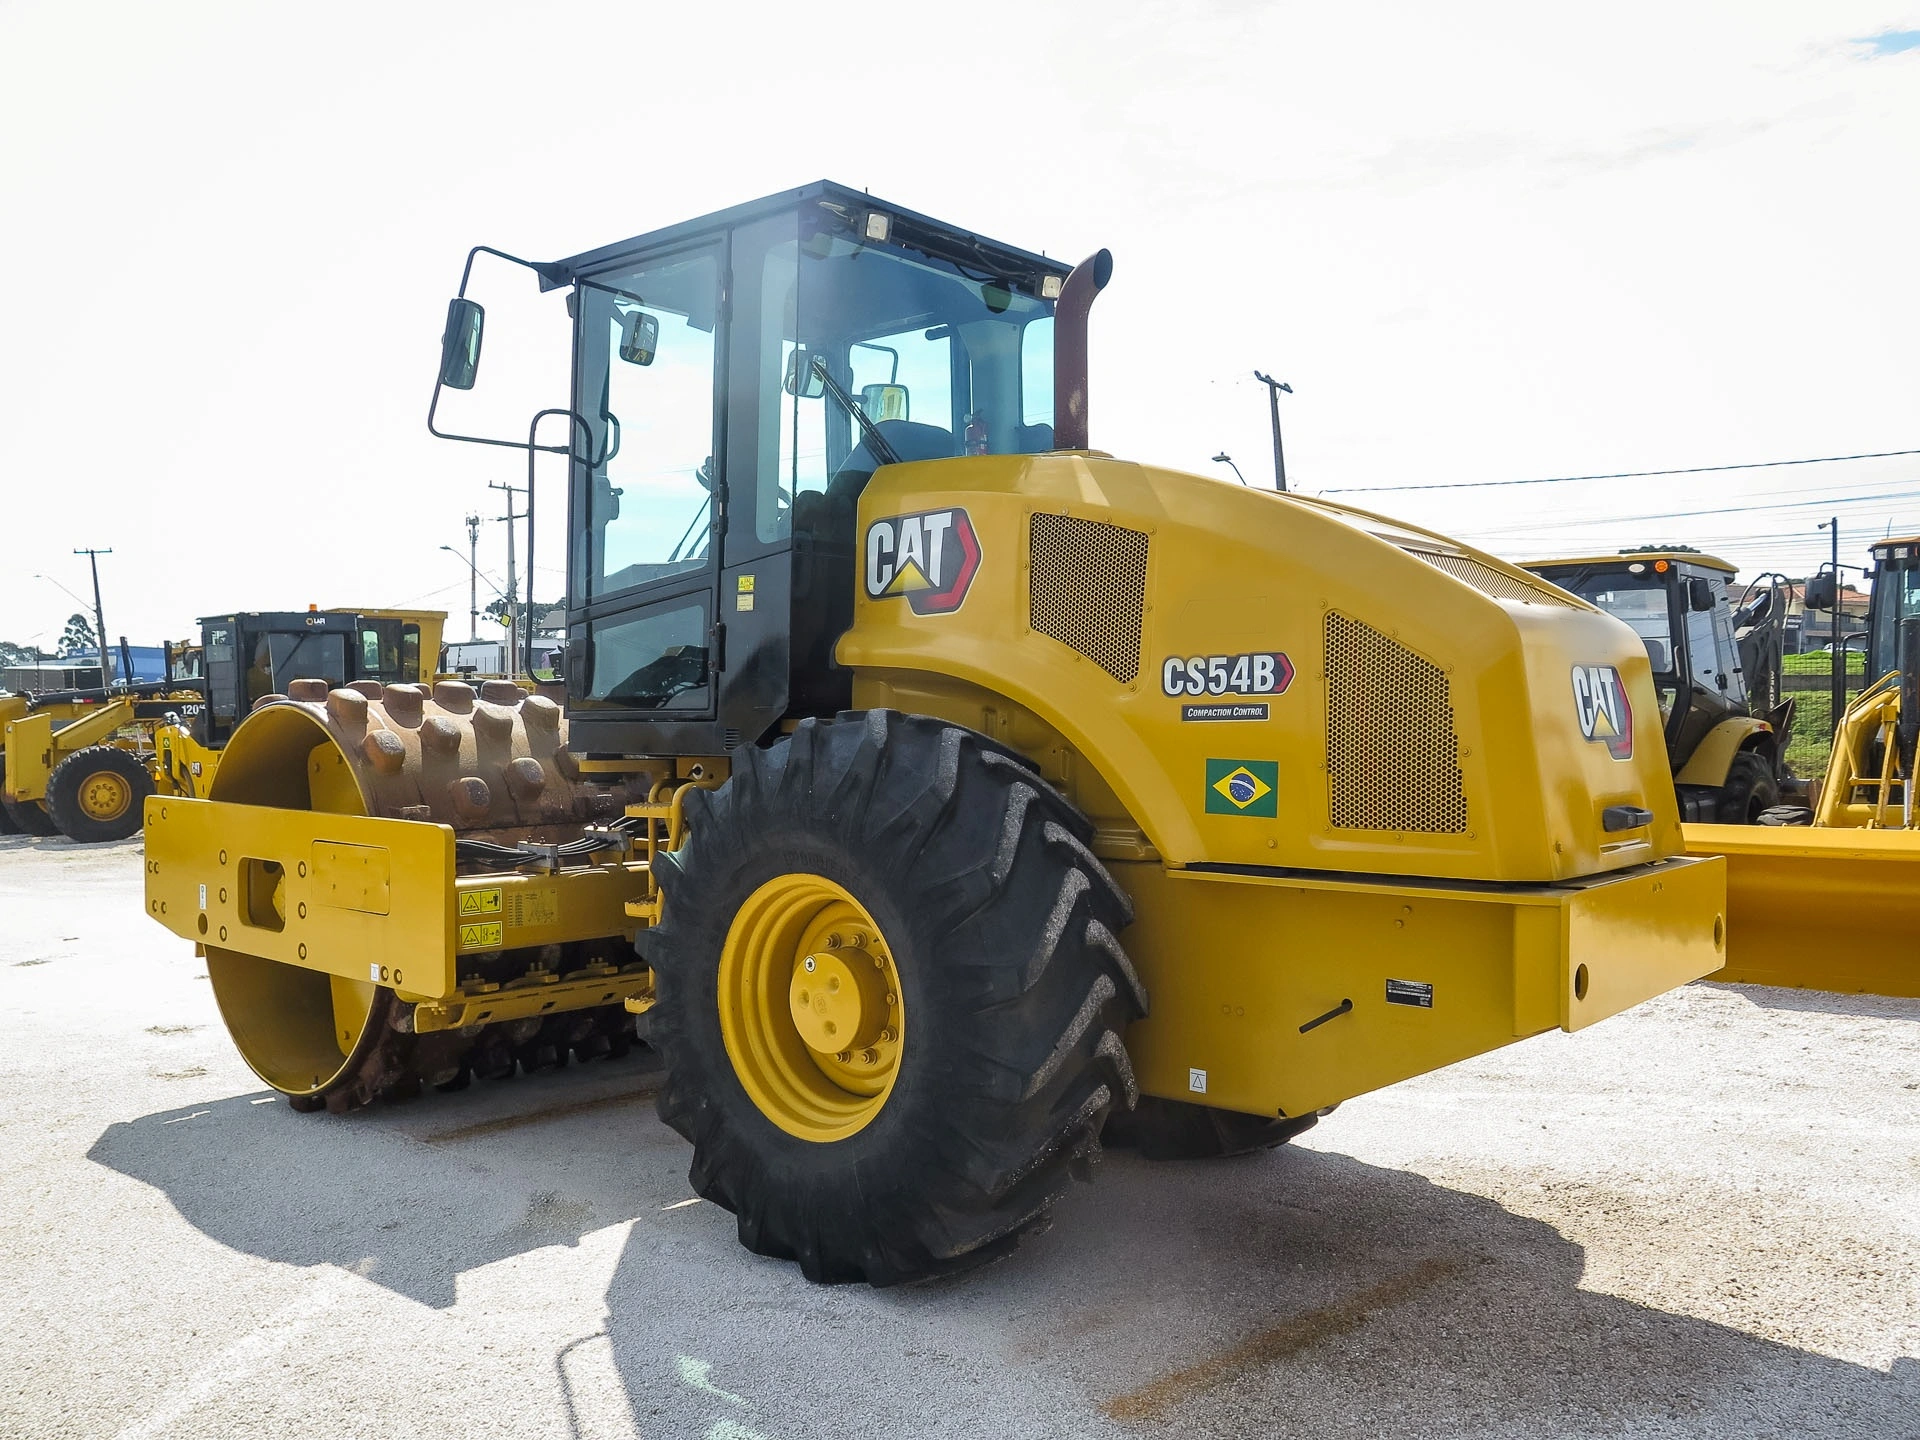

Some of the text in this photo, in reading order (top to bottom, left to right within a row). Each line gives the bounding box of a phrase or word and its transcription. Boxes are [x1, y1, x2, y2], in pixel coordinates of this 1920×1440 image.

[867, 511, 953, 596] CAT
[1163, 654, 1275, 696] CS54B
[181, 704, 199, 715] 120
[1187, 706, 1263, 718] COMPACTION CONTROL
[1572, 665, 1621, 738] CAT
